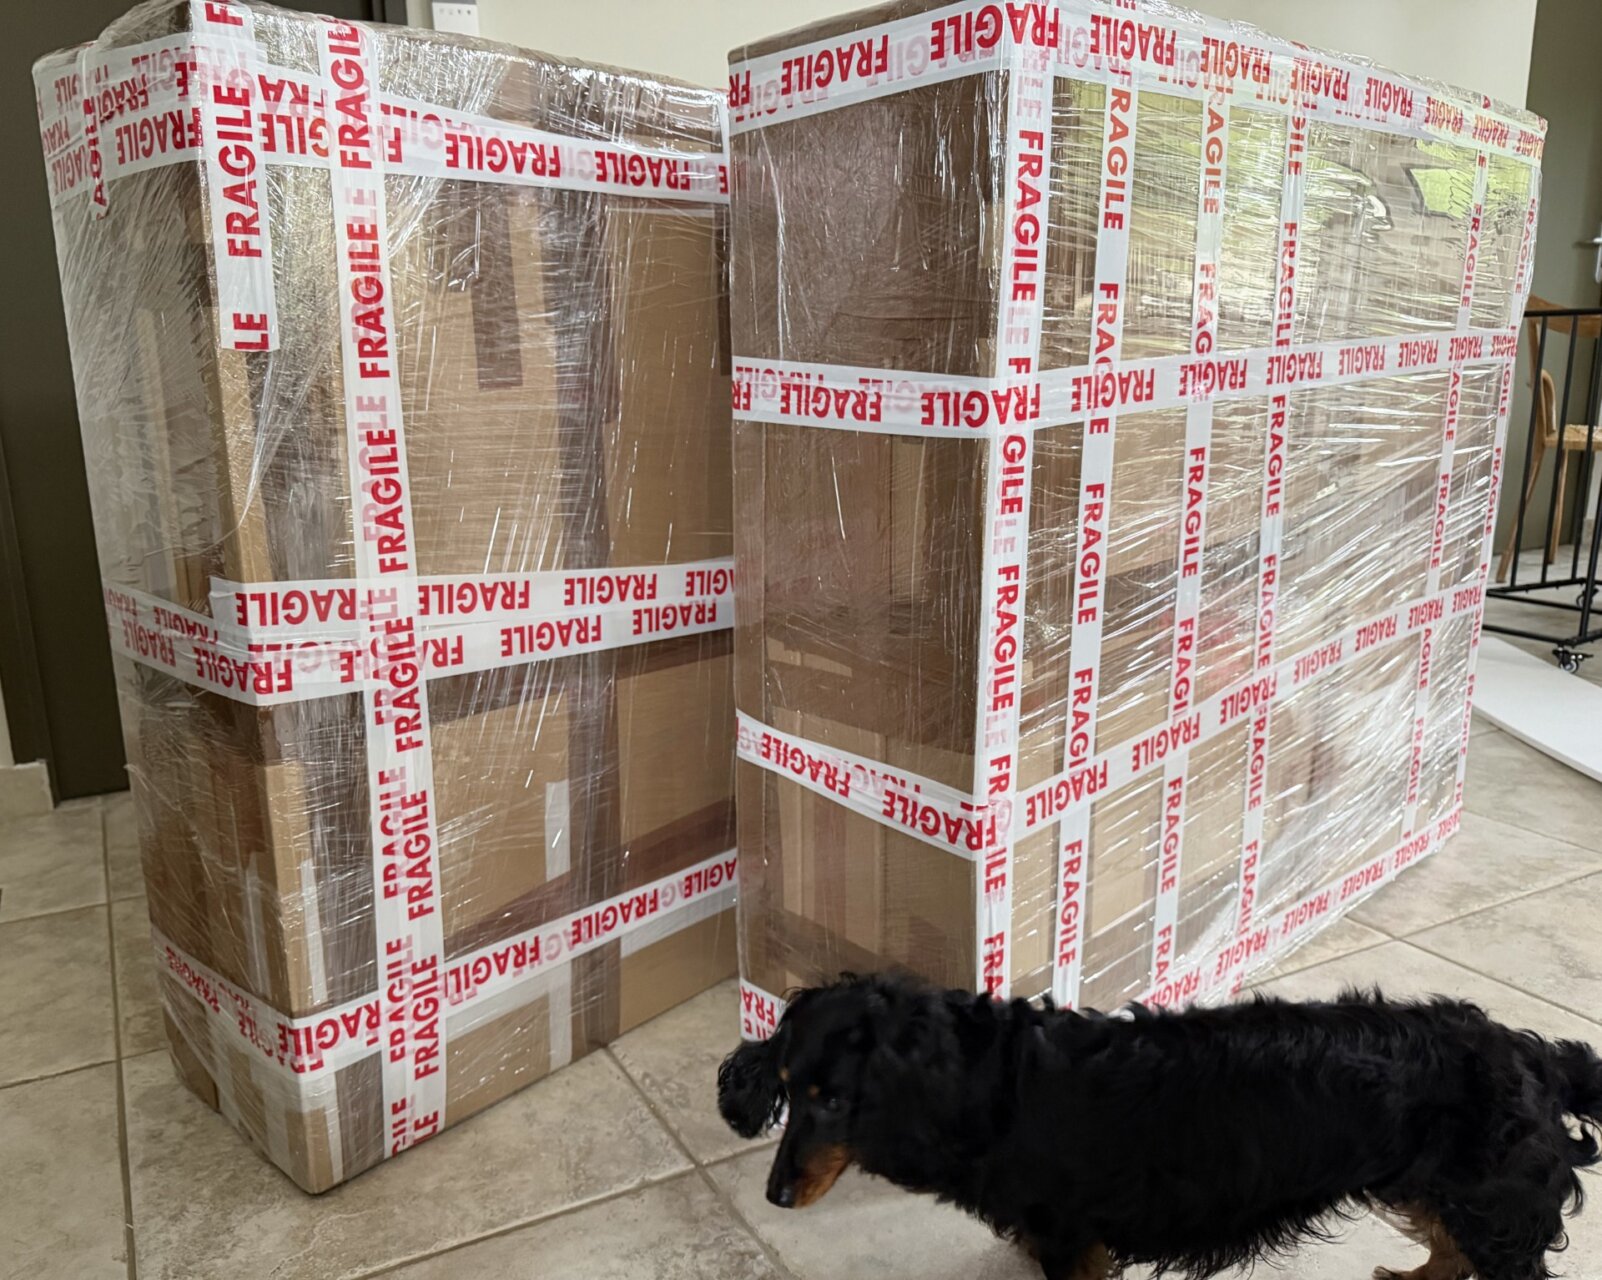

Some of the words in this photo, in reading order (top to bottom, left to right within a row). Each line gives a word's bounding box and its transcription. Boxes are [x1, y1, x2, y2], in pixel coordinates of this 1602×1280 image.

[930, 2, 1059, 61] FRAGILE
[1090, 14, 1176, 66] FRAGILE
[781, 34, 889, 96] FRAGILE
[1200, 37, 1273, 84] FRAGILE
[1290, 57, 1350, 101] FRAGILE
[1364, 77, 1413, 118] FRAGILE
[115, 108, 203, 165] FRAGILE
[444, 133, 561, 178] FRAGILE
[213, 84, 262, 258] FRAGILE
[594, 151, 690, 191] FRAGILE
[1012, 130, 1045, 301] FRAGILE
[1461, 203, 1482, 307] FRAGILE
[346, 222, 390, 378] FRAGILE
[1195, 263, 1217, 355] FRAG
[1276, 222, 1297, 353] FRAGILE
[232, 313, 269, 350] LE
[1339, 344, 1385, 376] FRAGILE
[1398, 339, 1438, 368] FRAGILE
[1448, 335, 1484, 361] FRAGILE
[1071, 367, 1155, 410] FRAGILE
[1178, 358, 1248, 397] FRAGILE
[1266, 351, 1323, 385] FRAGILE
[780, 383, 882, 422] FRAGILE
[920, 383, 1041, 429] FRAGILE
[1445, 371, 1460, 441] AGILE
[1266, 395, 1285, 518] FRAGILE
[366, 429, 408, 573] FRAGILE
[1182, 447, 1205, 578] FRAGILE
[1431, 473, 1449, 569] FRAGILE
[1078, 483, 1104, 625] FRAGILE
[418, 580, 530, 616] FRAGILE
[564, 573, 657, 606] FRAGILE
[632, 601, 717, 635] FRAGILE
[1257, 553, 1277, 670] FRAGILE
[1408, 596, 1444, 629] FRAGILE
[1452, 588, 1481, 613] FRAGILE
[501, 614, 601, 658] FRAGILE
[992, 565, 1019, 711] FRAGILE
[1294, 638, 1342, 683] FRAGILE
[1355, 613, 1398, 652] FRAGILE
[1418, 628, 1433, 689] AGILE
[192, 646, 294, 694] FRAGILE
[385, 617, 423, 752] FRAGILE
[1173, 617, 1194, 712] FRAGI
[1068, 668, 1093, 771] FRAGI
[1220, 671, 1277, 725] FRAGILE
[761, 732, 850, 798] FRAGILE
[1132, 712, 1200, 772] FRAGILE
[882, 788, 996, 851] FRAGILE
[1025, 760, 1107, 828] FRAGILE
[400, 790, 434, 921] FRAGILE
[1161, 776, 1182, 894] FRAGILE
[1394, 832, 1430, 869] FRAGILE
[1057, 839, 1082, 967] FRAGILE
[1340, 858, 1385, 901] FRAGILE
[571, 888, 658, 946] FRAGILE
[1282, 889, 1330, 935] FRAGILE
[1216, 924, 1268, 976] FRAGILE
[411, 954, 439, 1080] FRAGILE
